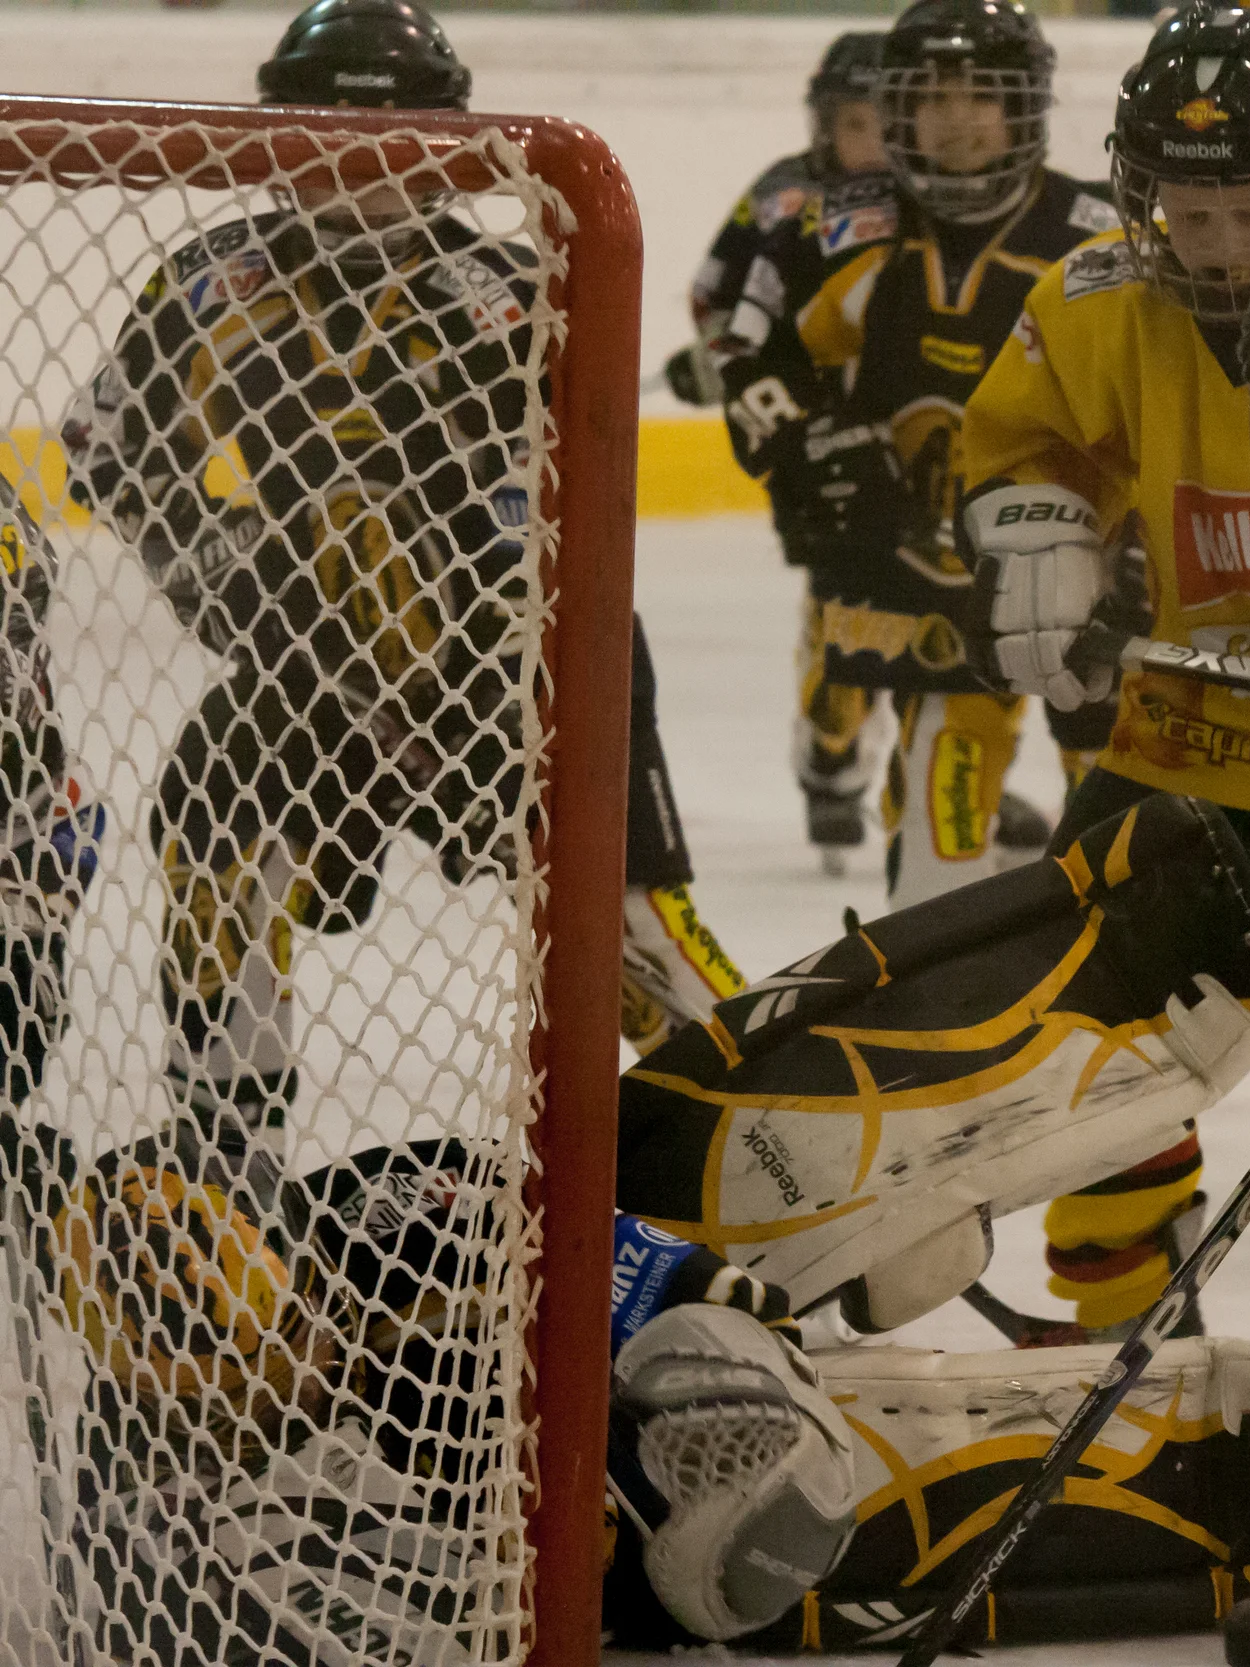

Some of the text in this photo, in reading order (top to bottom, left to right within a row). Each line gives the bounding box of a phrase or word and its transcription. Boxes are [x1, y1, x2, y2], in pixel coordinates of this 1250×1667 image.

[1162, 140, 1233, 159] Reebok
[741, 1126, 805, 1207] Reebok
[623, 1251, 677, 1334] MARKSTEINER
[951, 1520, 1028, 1624] SICKICK
